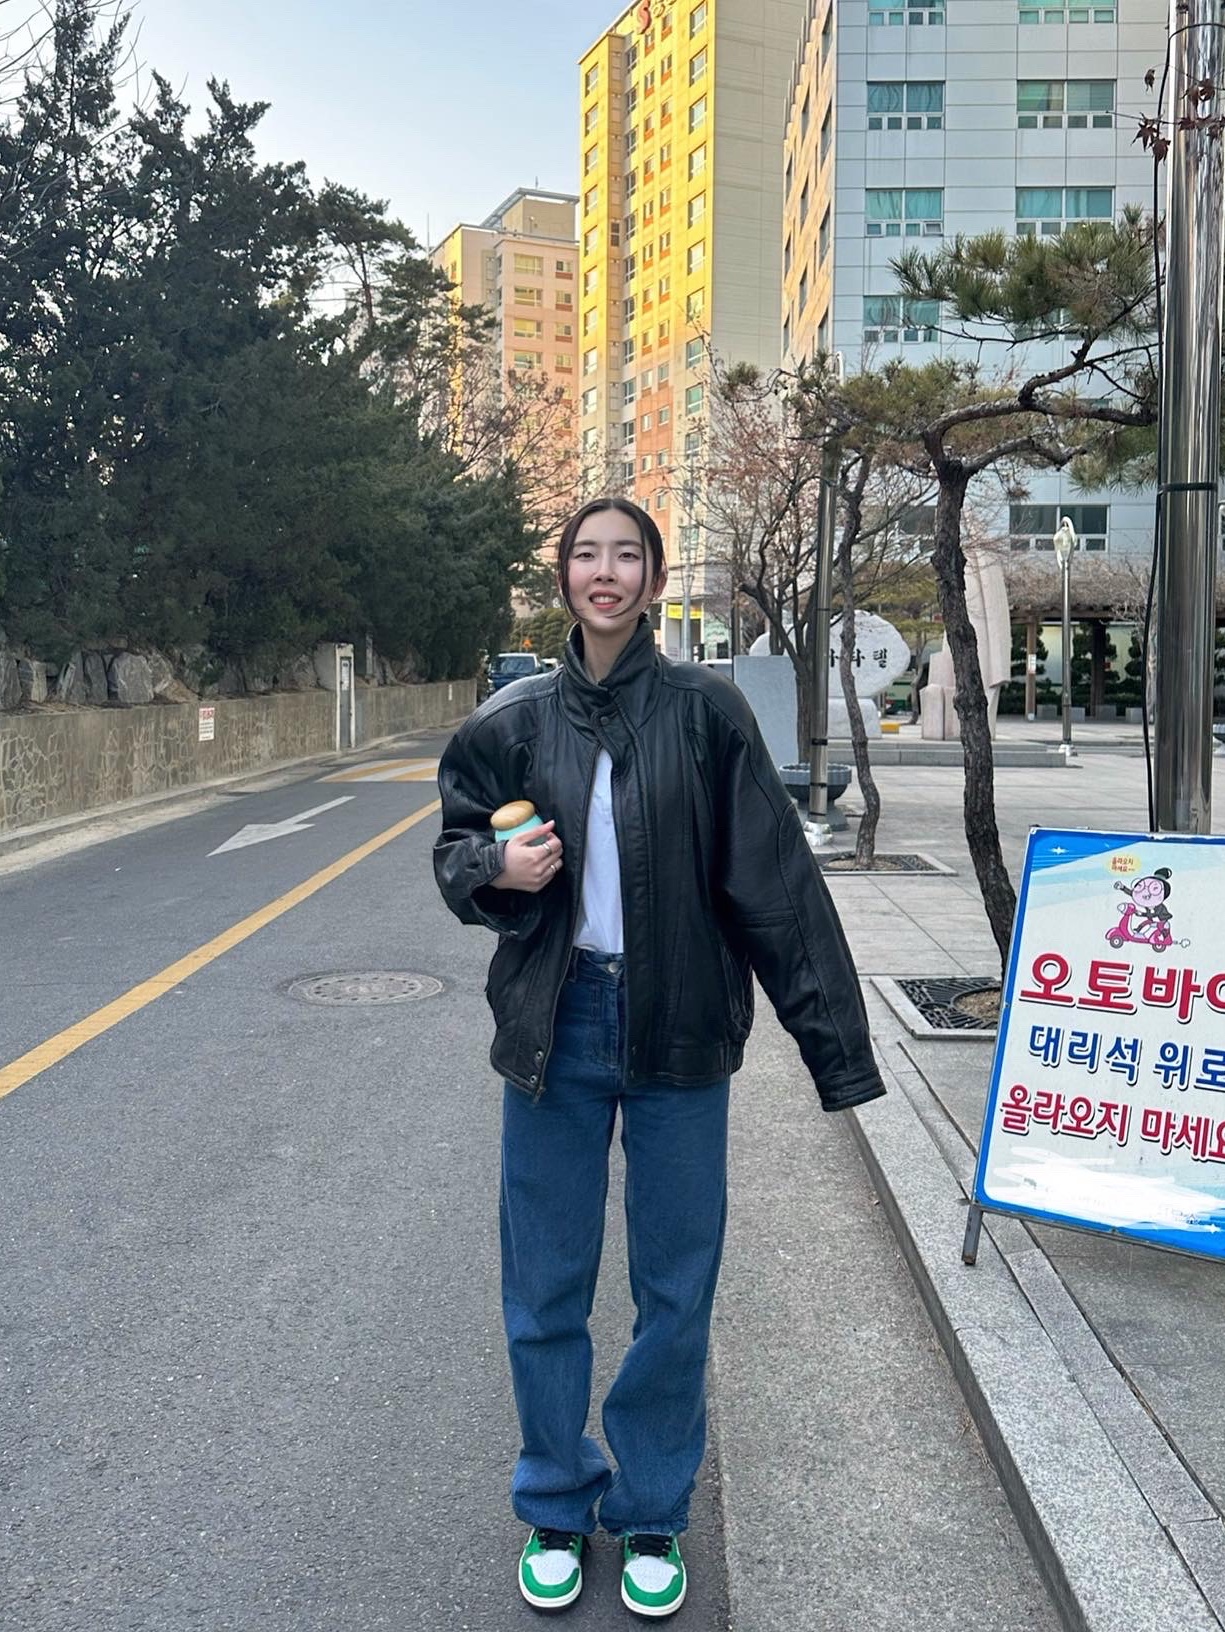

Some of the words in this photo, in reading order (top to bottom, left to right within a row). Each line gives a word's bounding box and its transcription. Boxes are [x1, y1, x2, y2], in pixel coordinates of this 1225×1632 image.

[1019, 953, 1225, 1021] 오토바
[1029, 1025, 1140, 1083] 대리석
[1154, 1041, 1225, 1089] 위로
[1001, 1084, 1130, 1144] 올라오지
